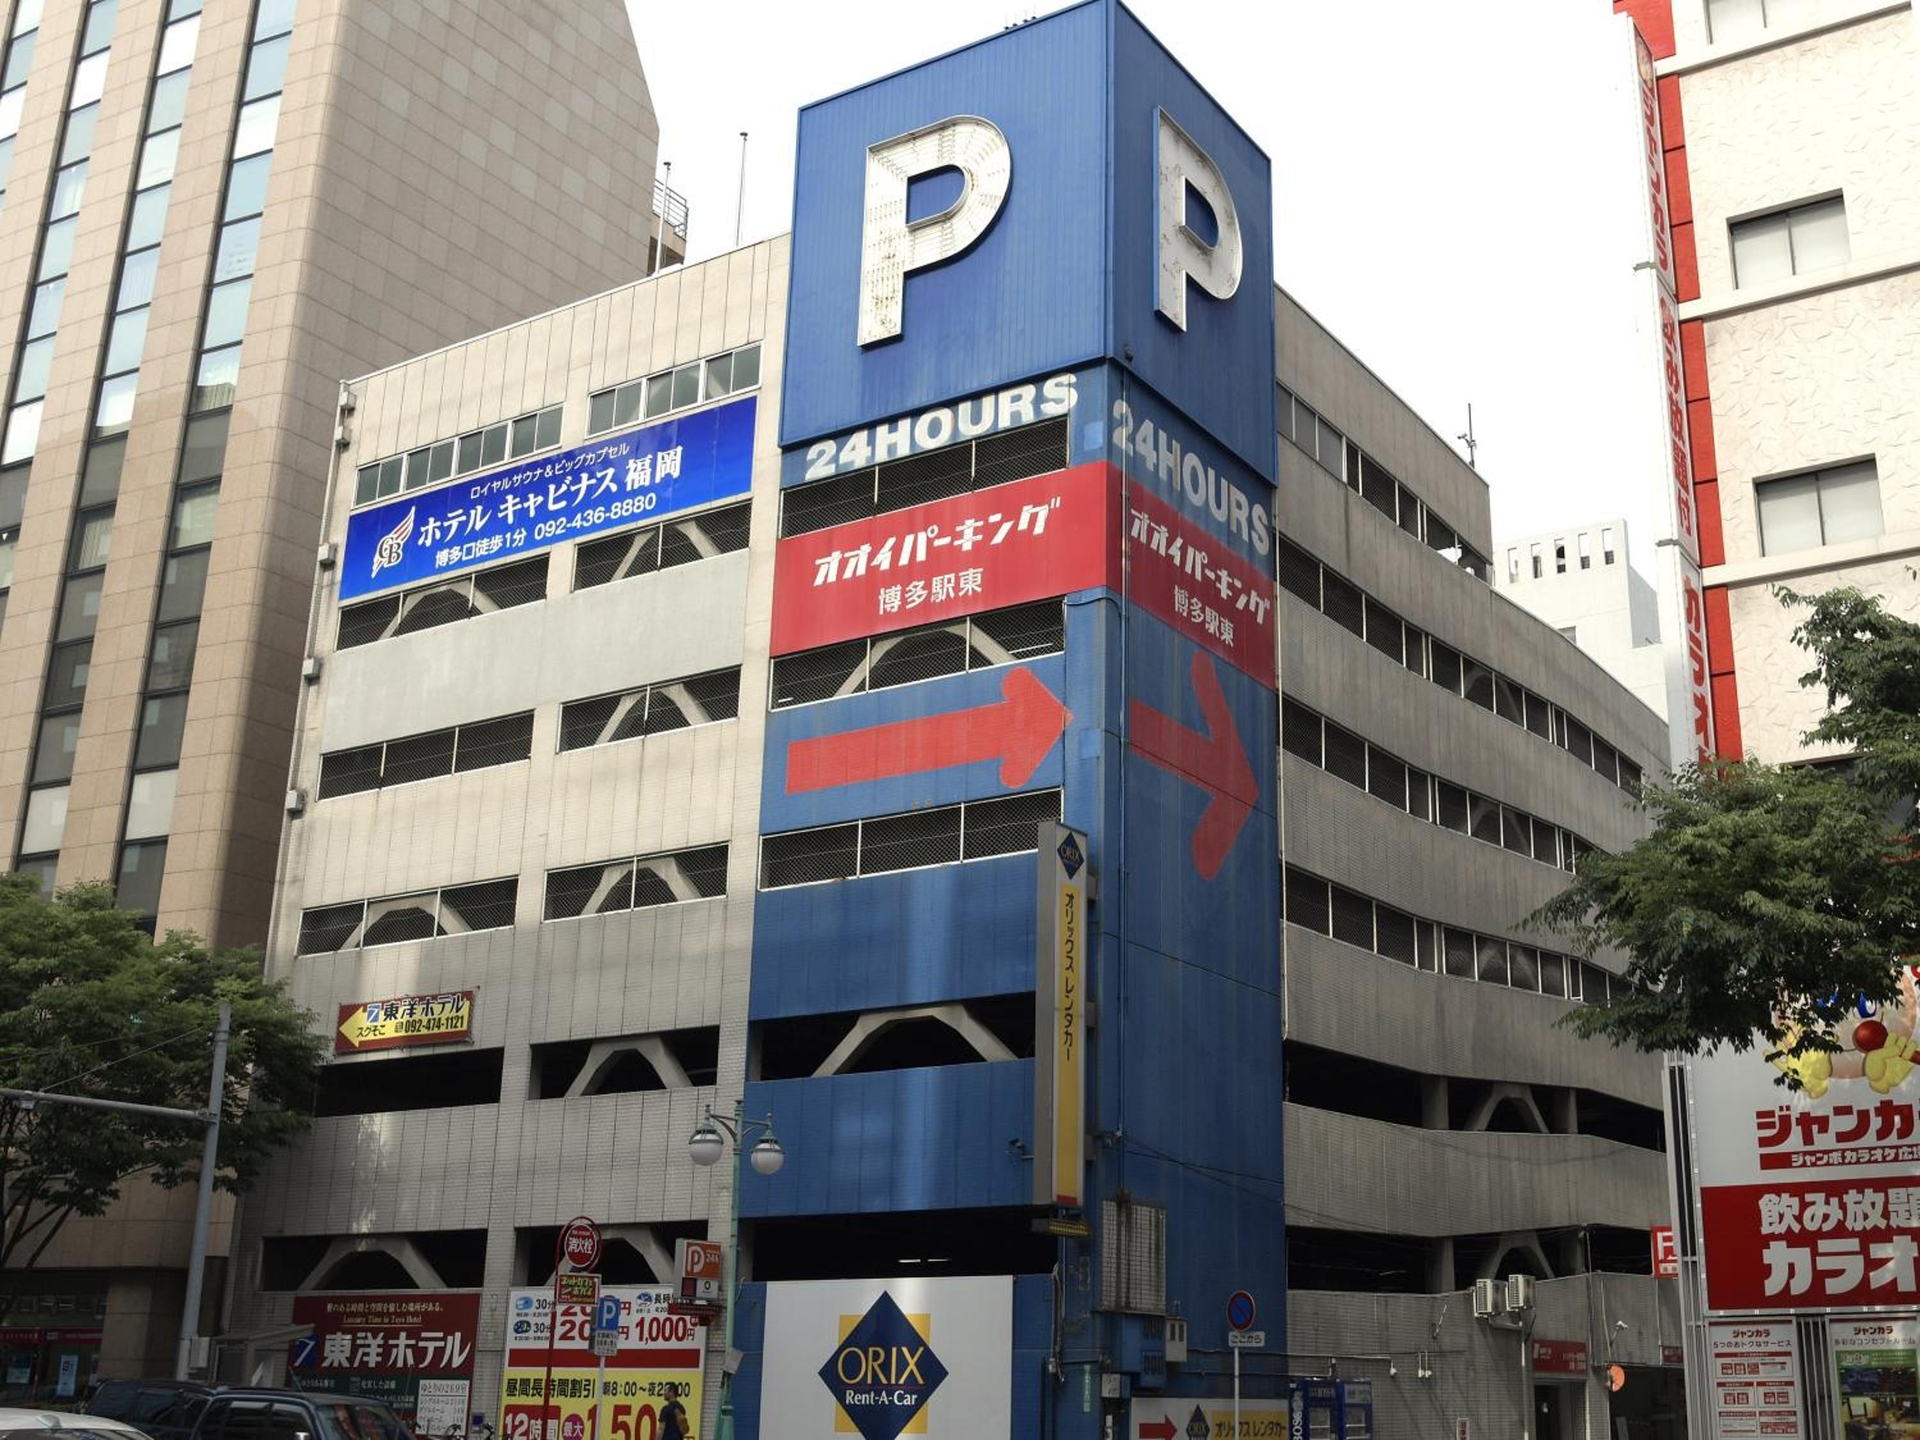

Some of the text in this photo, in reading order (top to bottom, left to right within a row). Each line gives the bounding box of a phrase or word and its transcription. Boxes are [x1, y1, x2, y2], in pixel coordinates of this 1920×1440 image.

[857, 115, 1012, 348] P
[1154, 105, 1244, 333] P
[805, 372, 1079, 482] 24HOURS
[417, 444, 684, 548] ホテル キャビナス 福岡
[1112, 399, 1271, 557] 24HOURS
[434, 492, 657, 570] 博多口徒歩1分 092-436-8880
[812, 496, 1062, 587] オオイパーキング
[1130, 508, 1271, 626] オオイパーキング
[877, 567, 985, 617] 博多駅東
[1172, 584, 1236, 649] 博多駅東
[383, 993, 466, 1022] 東洋ホテル
[356, 1024, 387, 1039] スグそこ
[1755, 1099, 1920, 1149] ジャンカ
[1758, 1185, 1920, 1235] 飲み放題
[568, 1237, 594, 1254] 消火栓
[687, 1245, 705, 1273] P
[602, 1302, 616, 1327] P
[1732, 1328, 1771, 1338] ジャンカラ
[1853, 1326, 1894, 1336] ジャンカラ
[321, 1331, 472, 1369] 東洋ホテル
[1230, 1334, 1262, 1344] ここから
[837, 1346, 925, 1385] ORIX
[845, 1389, 918, 1406] Rent-A-Car
[563, 1421, 584, 1437] 最大
